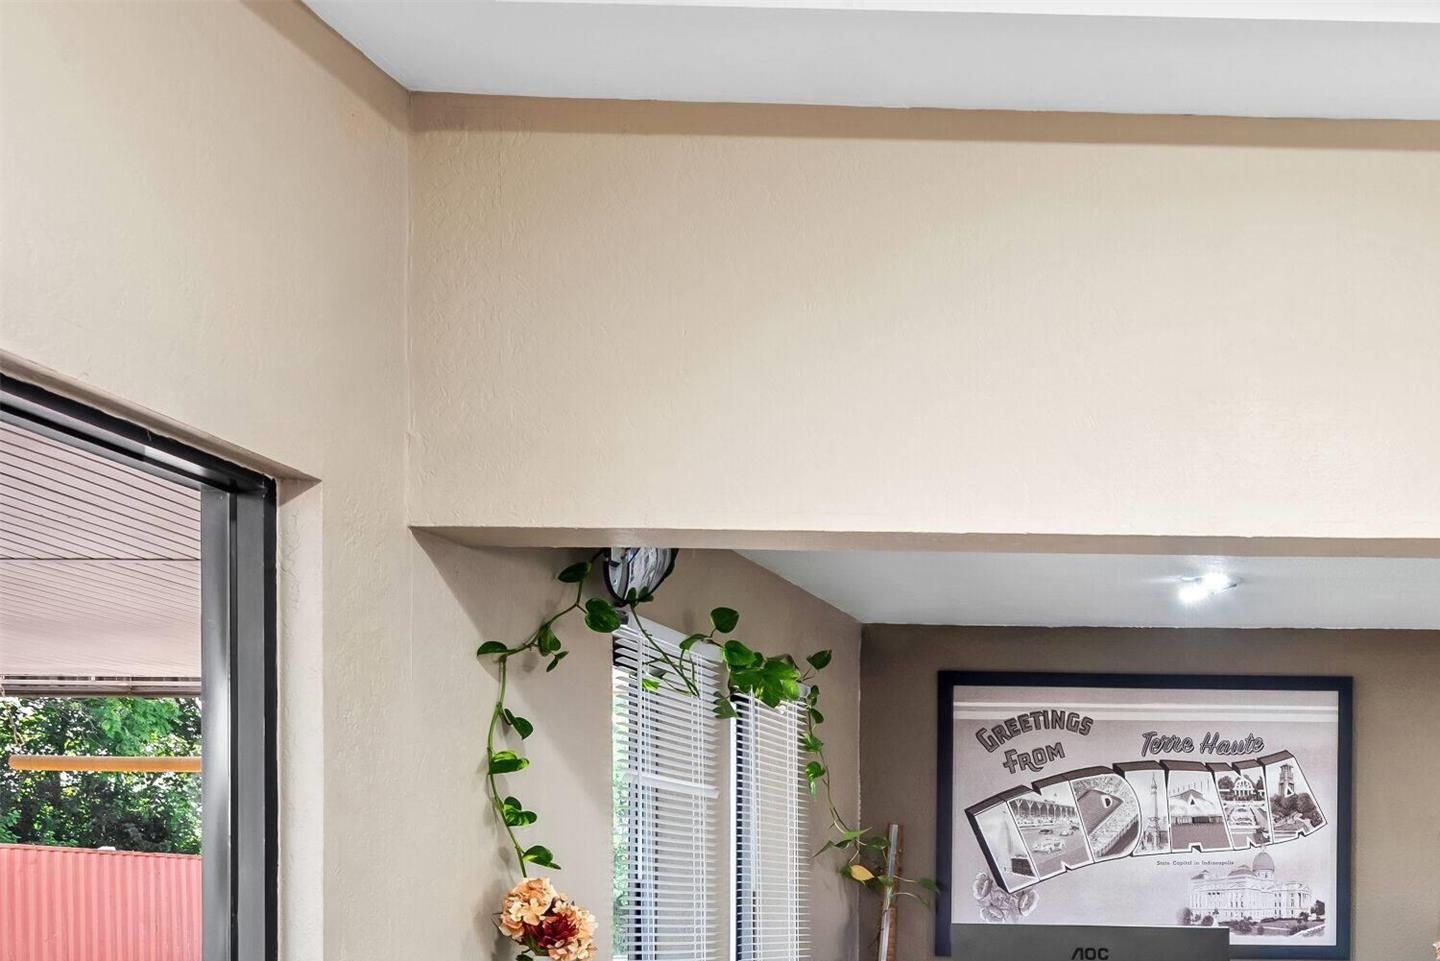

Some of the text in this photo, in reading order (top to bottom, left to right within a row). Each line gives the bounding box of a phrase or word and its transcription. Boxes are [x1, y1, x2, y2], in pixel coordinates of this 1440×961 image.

[975, 709, 1094, 753] GREETINGS
[1140, 731, 1264, 757] Terre Haute
[1003, 742, 1066, 774] FROM
[964, 750, 1328, 894] INDIANA
[1071, 947, 1109, 961] AOC
